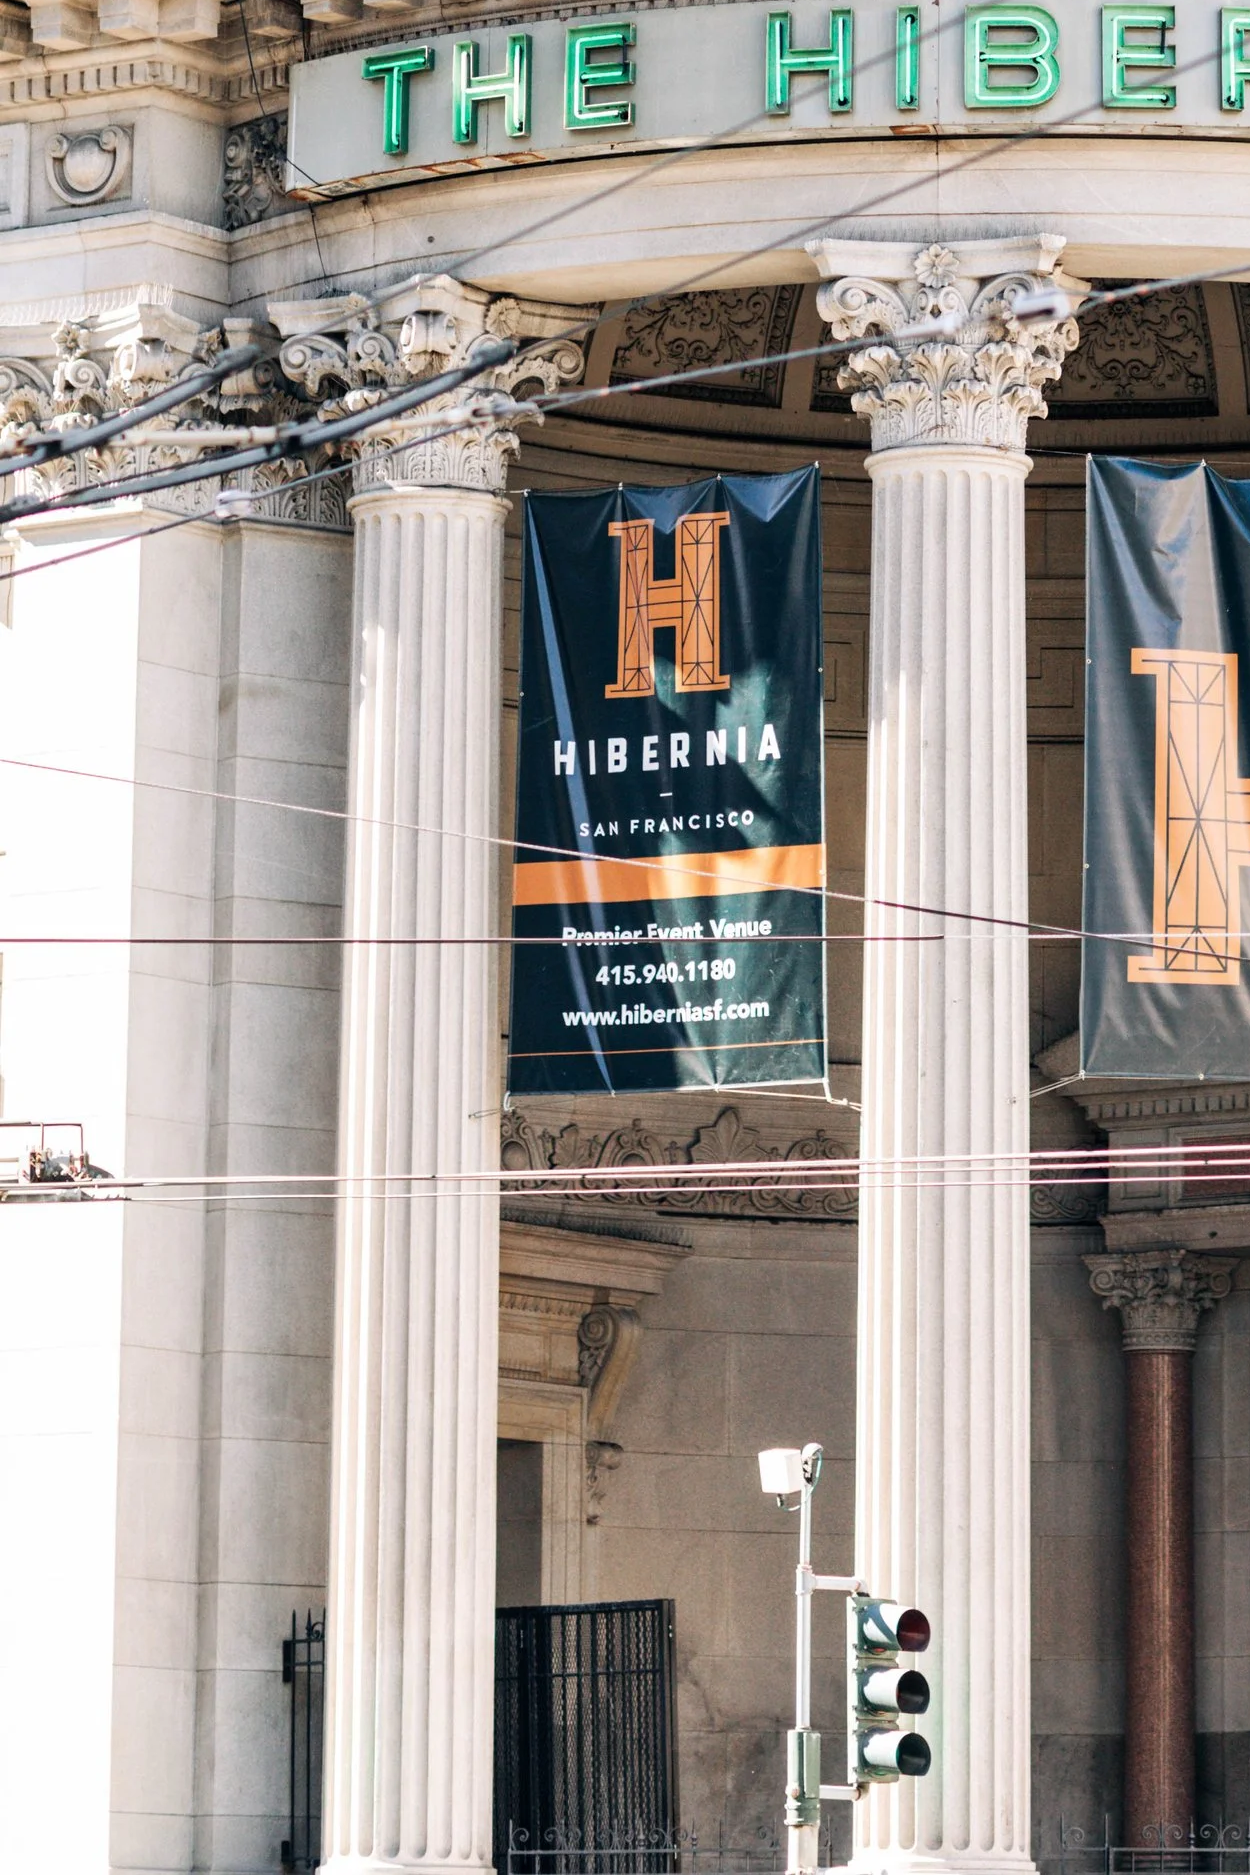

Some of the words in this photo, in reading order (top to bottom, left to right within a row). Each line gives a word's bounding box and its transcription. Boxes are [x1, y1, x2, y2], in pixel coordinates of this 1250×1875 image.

[361, 21, 637, 156] THE
[605, 511, 730, 698] H
[553, 723, 781, 776] HIBERNIA
[579, 822, 618, 837] SAN
[630, 809, 755, 834] FRANCISCO
[562, 926, 643, 947] Premier
[646, 923, 704, 941] Event
[709, 918, 773, 938] Venue
[595, 958, 736, 986] 415.940.1180
[562, 998, 770, 1026] www.hiberniasf.com
